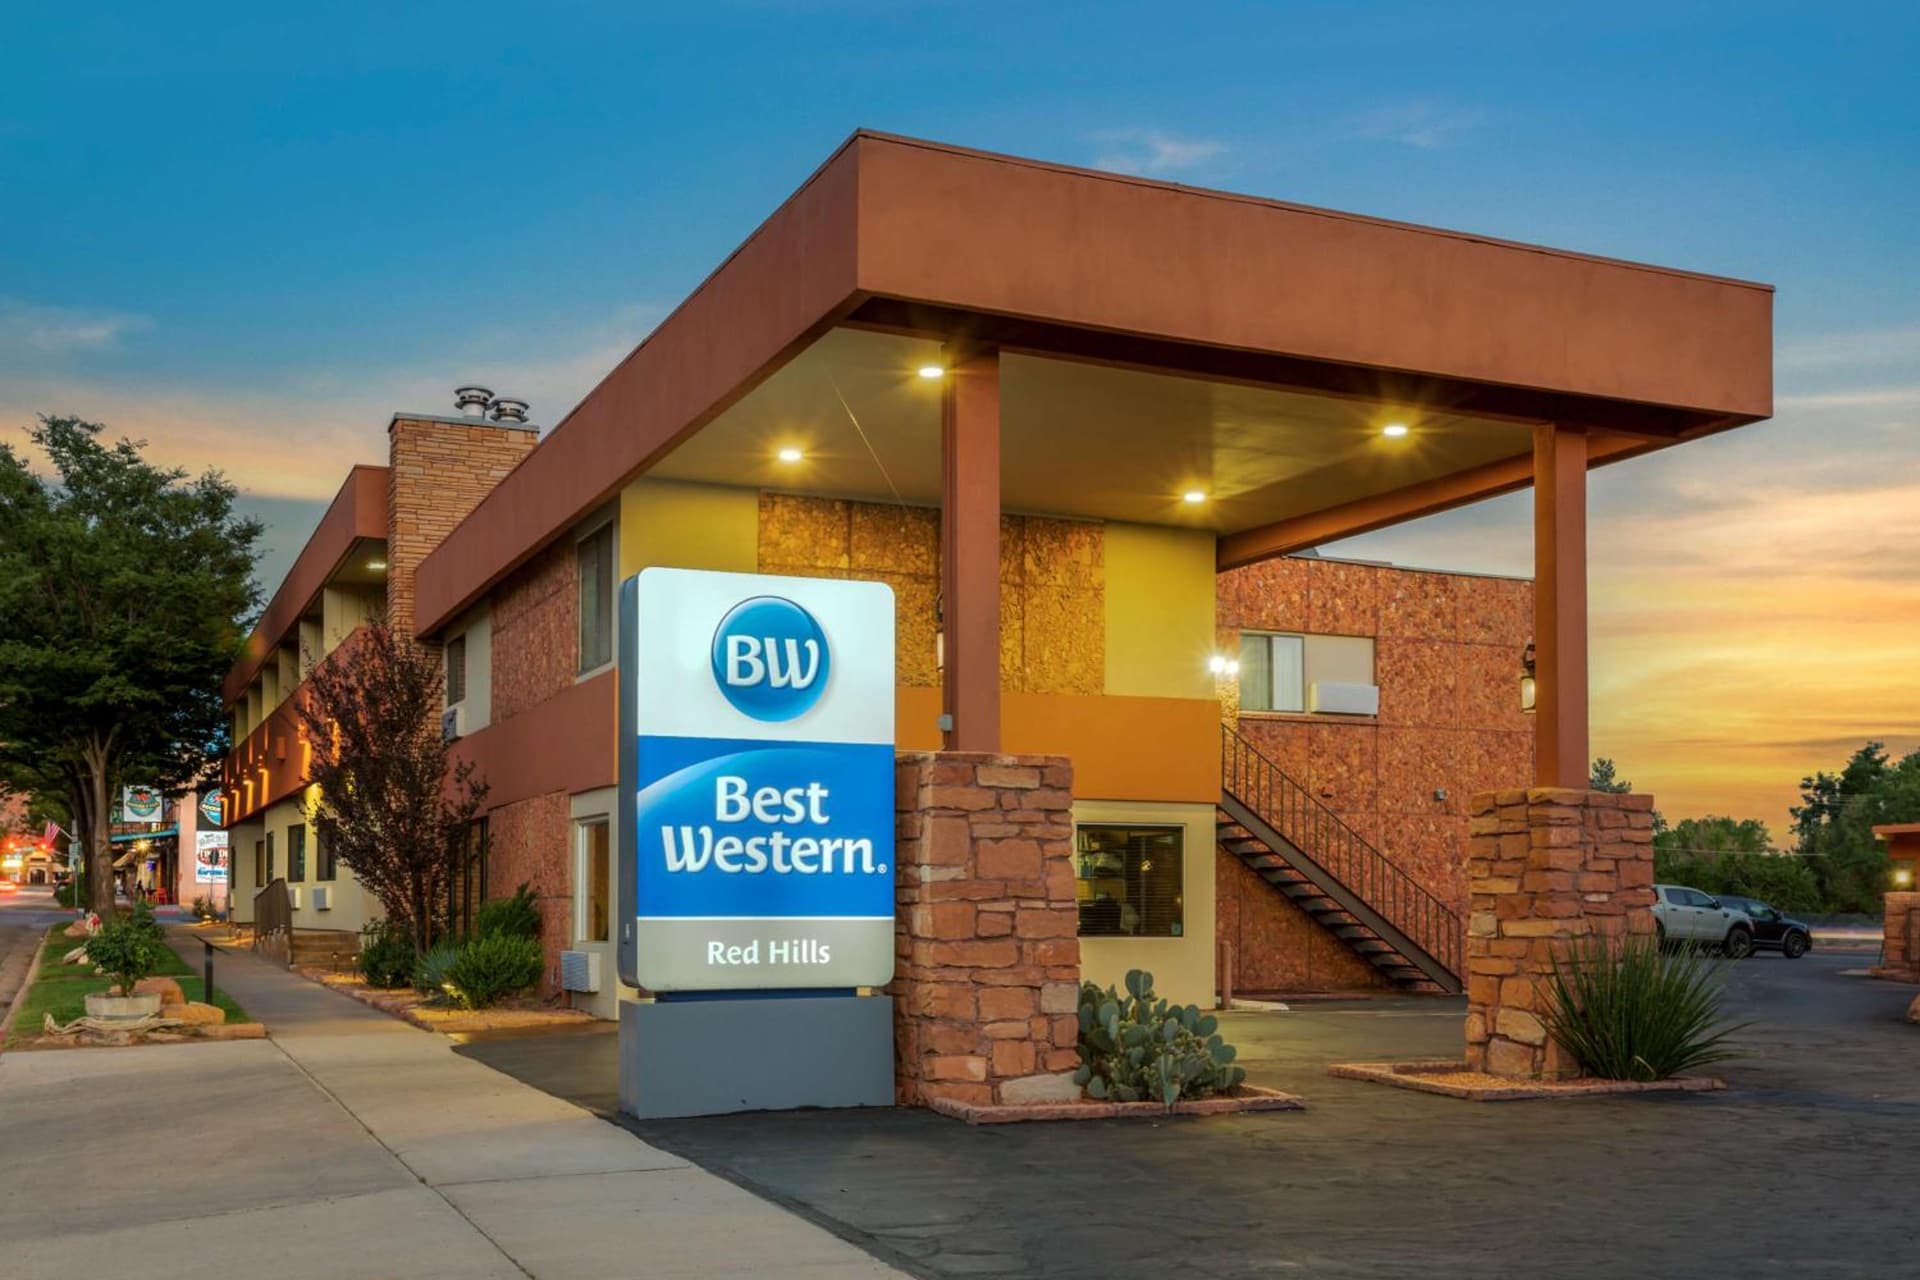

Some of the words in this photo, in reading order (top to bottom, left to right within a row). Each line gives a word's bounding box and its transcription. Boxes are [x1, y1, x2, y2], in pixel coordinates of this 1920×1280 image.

[725, 634, 821, 690] BW
[715, 775, 830, 825] Best
[706, 939, 760, 965] Red
[768, 938, 831, 965] Hills
